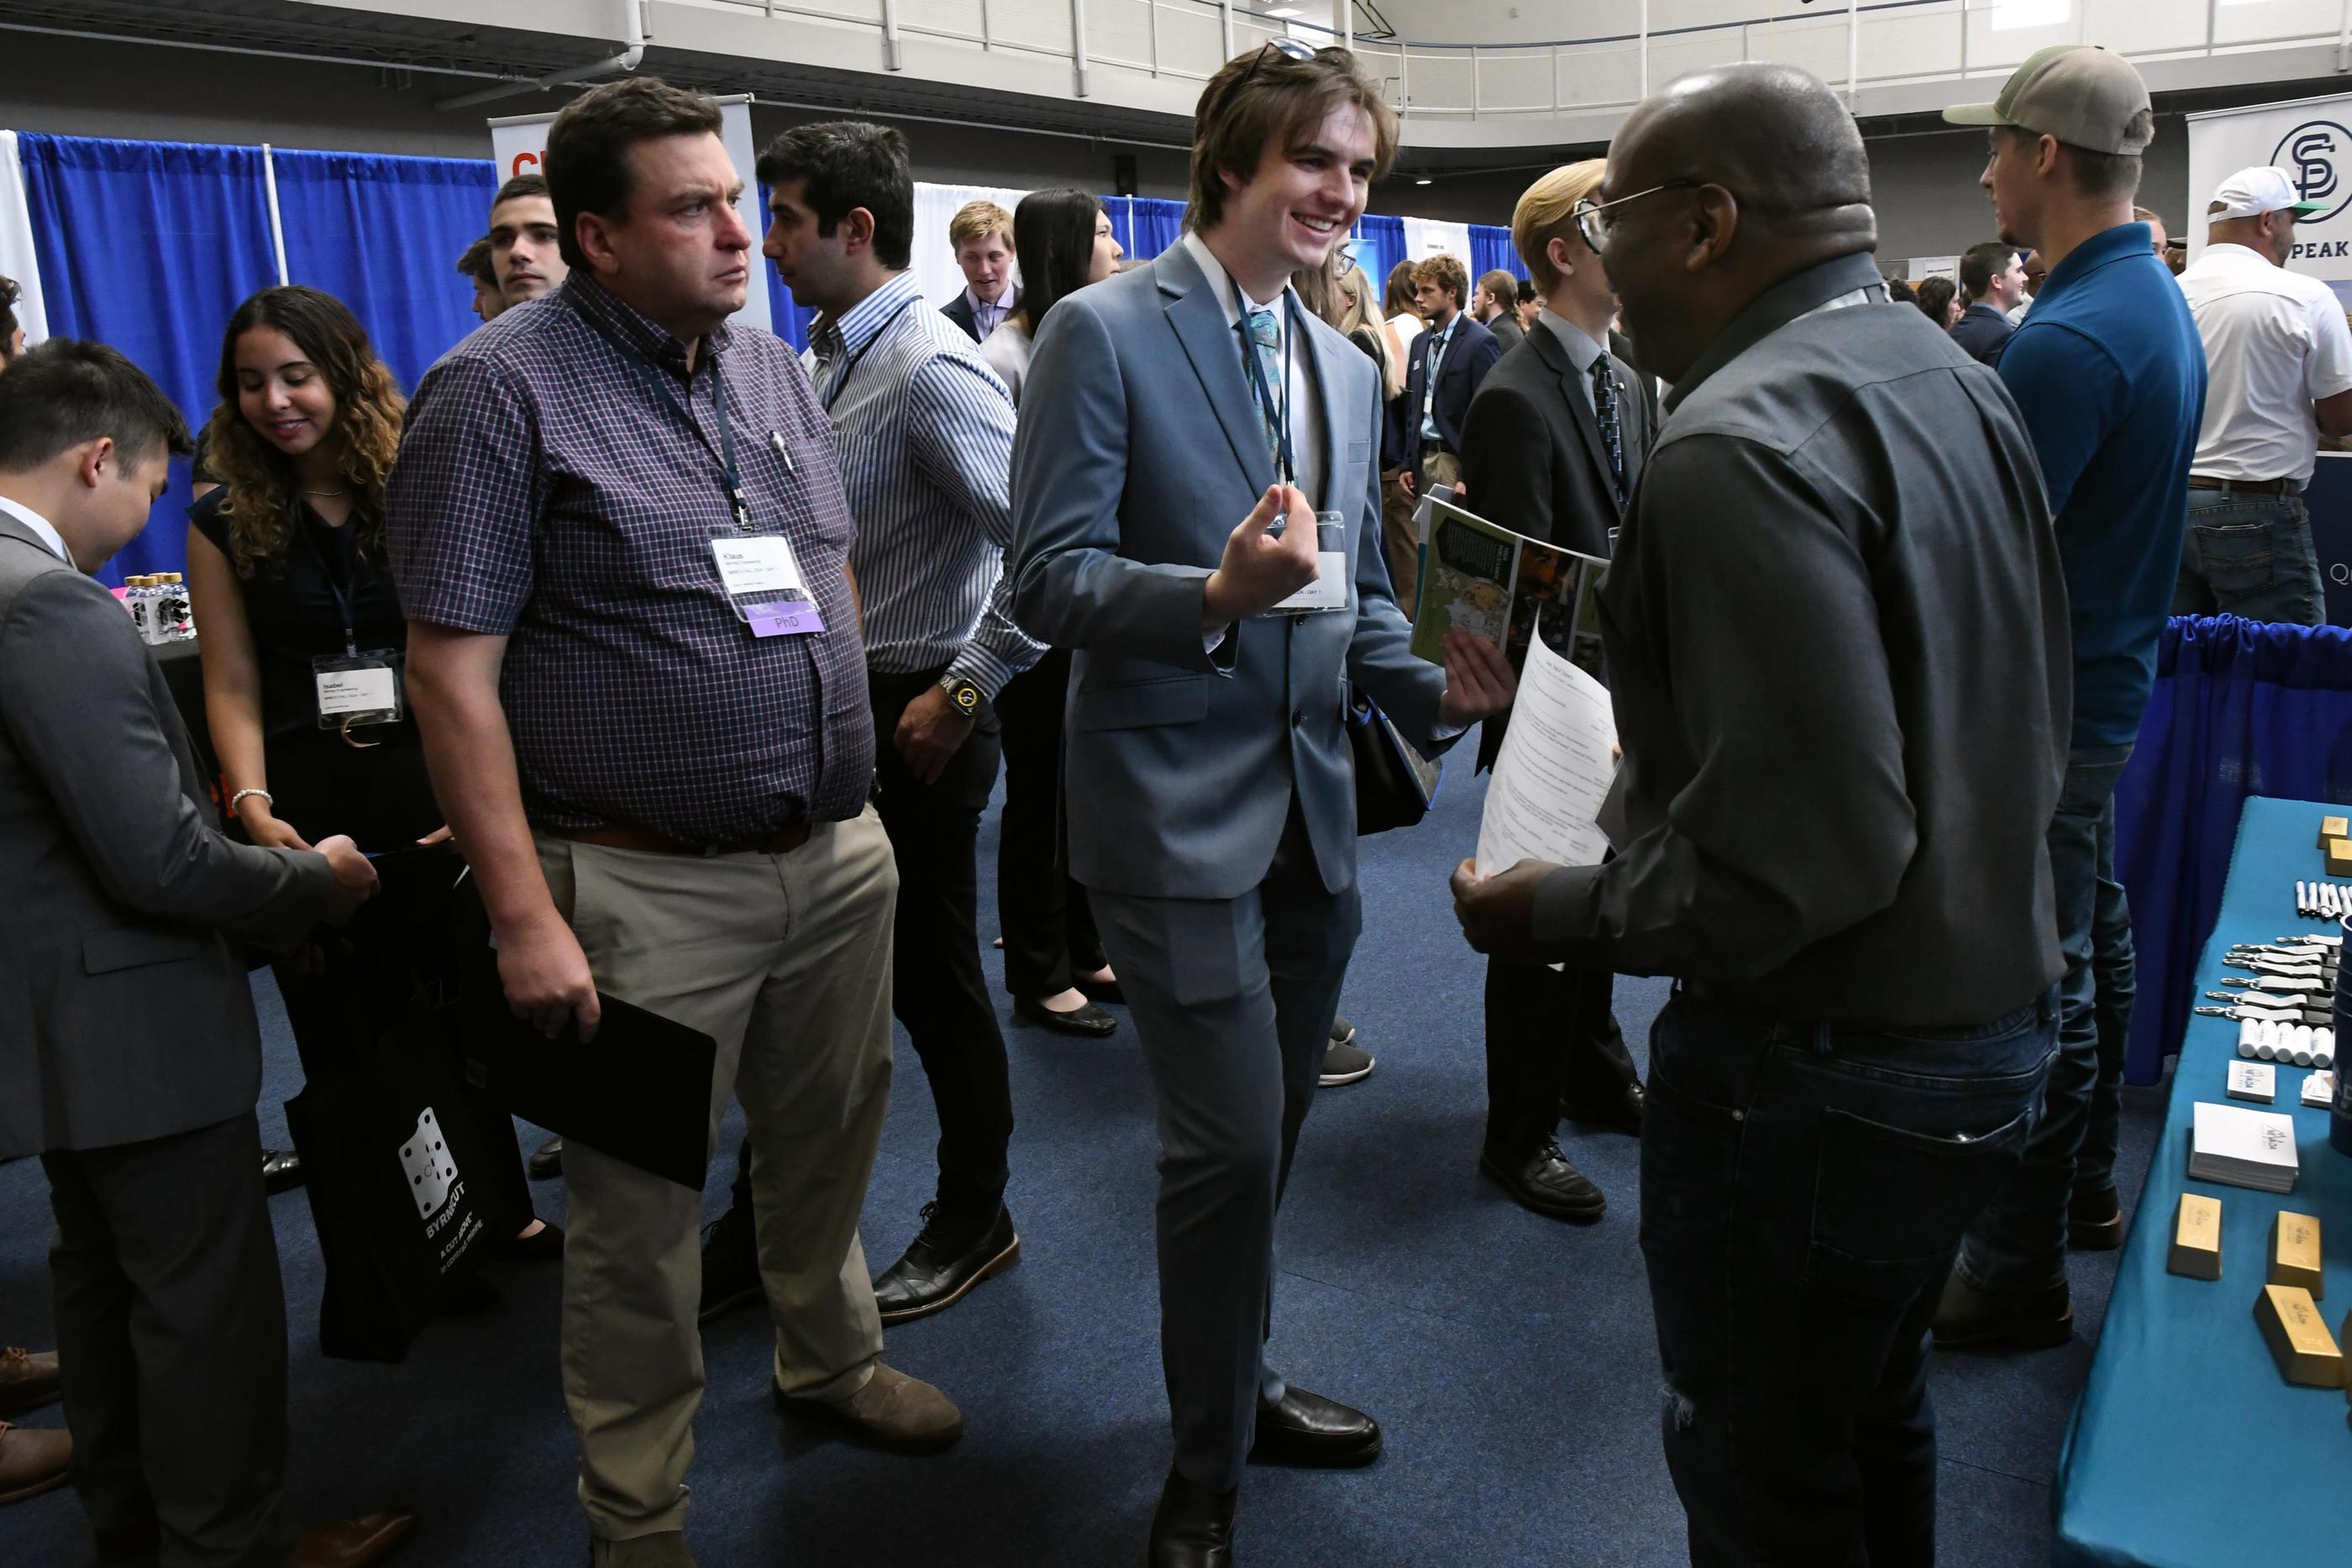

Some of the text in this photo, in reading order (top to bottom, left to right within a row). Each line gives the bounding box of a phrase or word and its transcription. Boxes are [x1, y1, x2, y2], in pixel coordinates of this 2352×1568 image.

[2292, 241, 2349, 260] PEAK
[2330, 563, 2352, 585] Q
[774, 616, 800, 628] PhD
[426, 1181, 465, 1240] BYRNECUT
